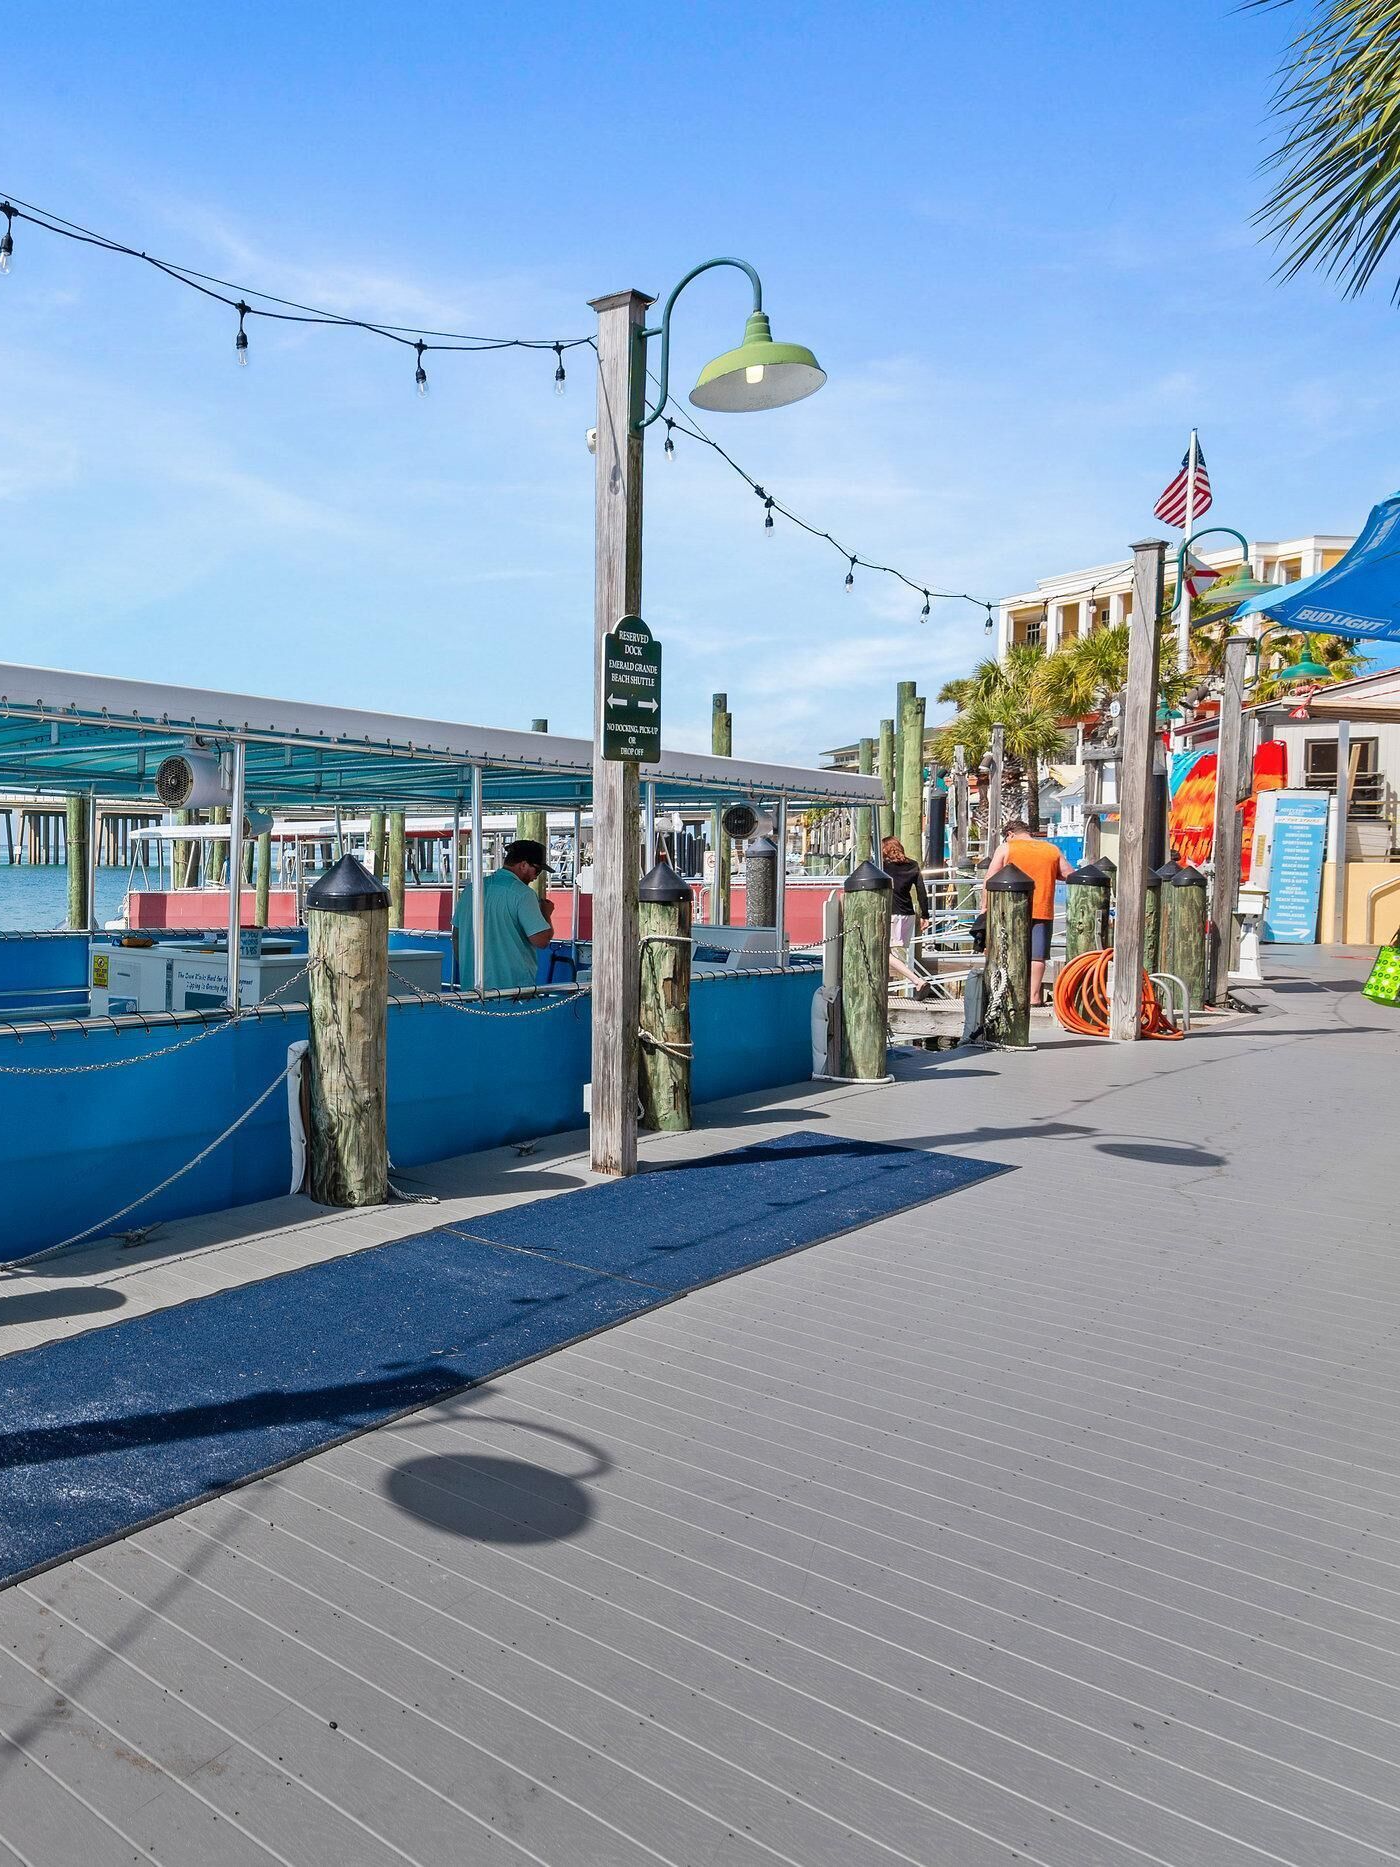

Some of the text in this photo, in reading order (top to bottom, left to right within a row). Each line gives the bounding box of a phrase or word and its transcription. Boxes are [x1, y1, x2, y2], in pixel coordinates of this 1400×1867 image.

[1296, 609, 1385, 631] BUD LIGHT
[618, 630, 649, 644] RESERVED
[624, 645, 642, 656] DOCK
[609, 659, 658, 675] EMERALD GRANDE
[611, 673, 655, 687] BEACH SHUTTLE
[606, 722, 614, 731] NO
[639, 725, 658, 735] PICK-UP
[628, 736, 637, 745] OR
[620, 746, 645, 757] DROP OFF
